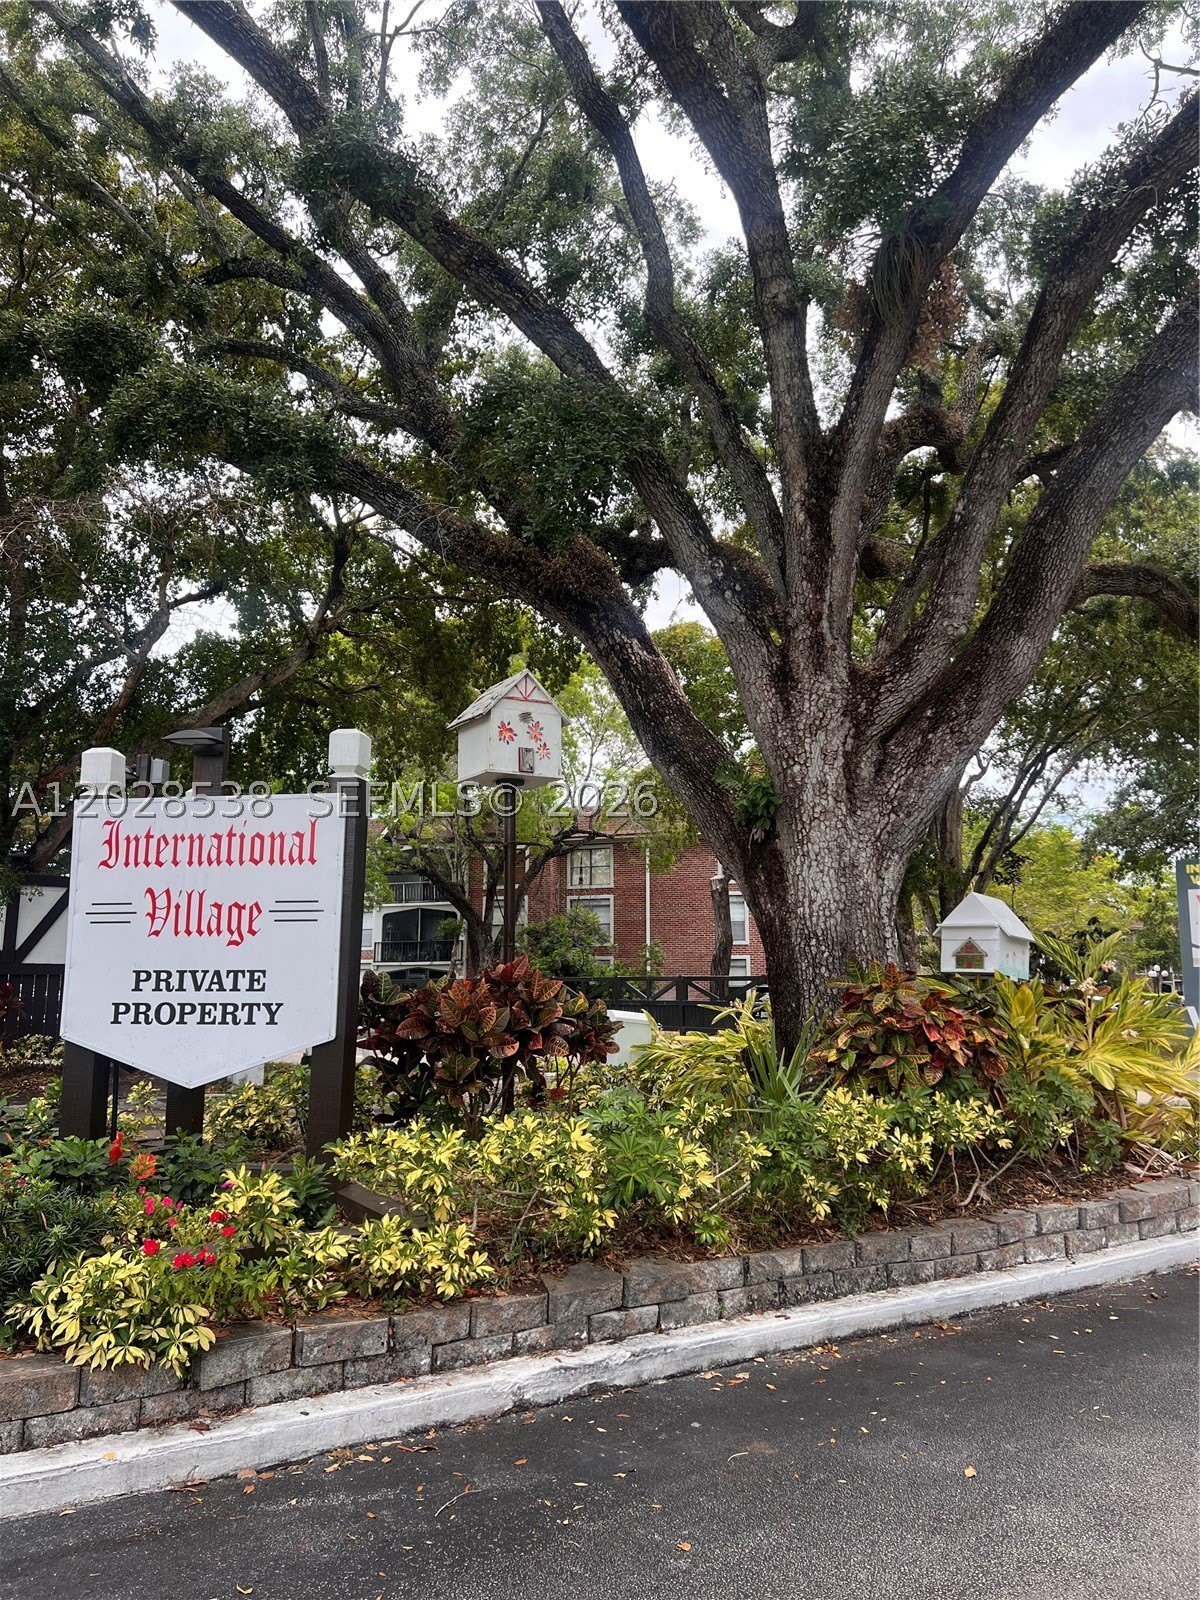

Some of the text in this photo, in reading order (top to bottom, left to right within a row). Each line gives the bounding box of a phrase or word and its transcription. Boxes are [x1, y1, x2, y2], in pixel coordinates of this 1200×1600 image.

[98, 818, 319, 869] International
[144, 887, 263, 947] Village
[131, 969, 267, 993] PRIVATE
[110, 1001, 284, 1026] PROPERTY
